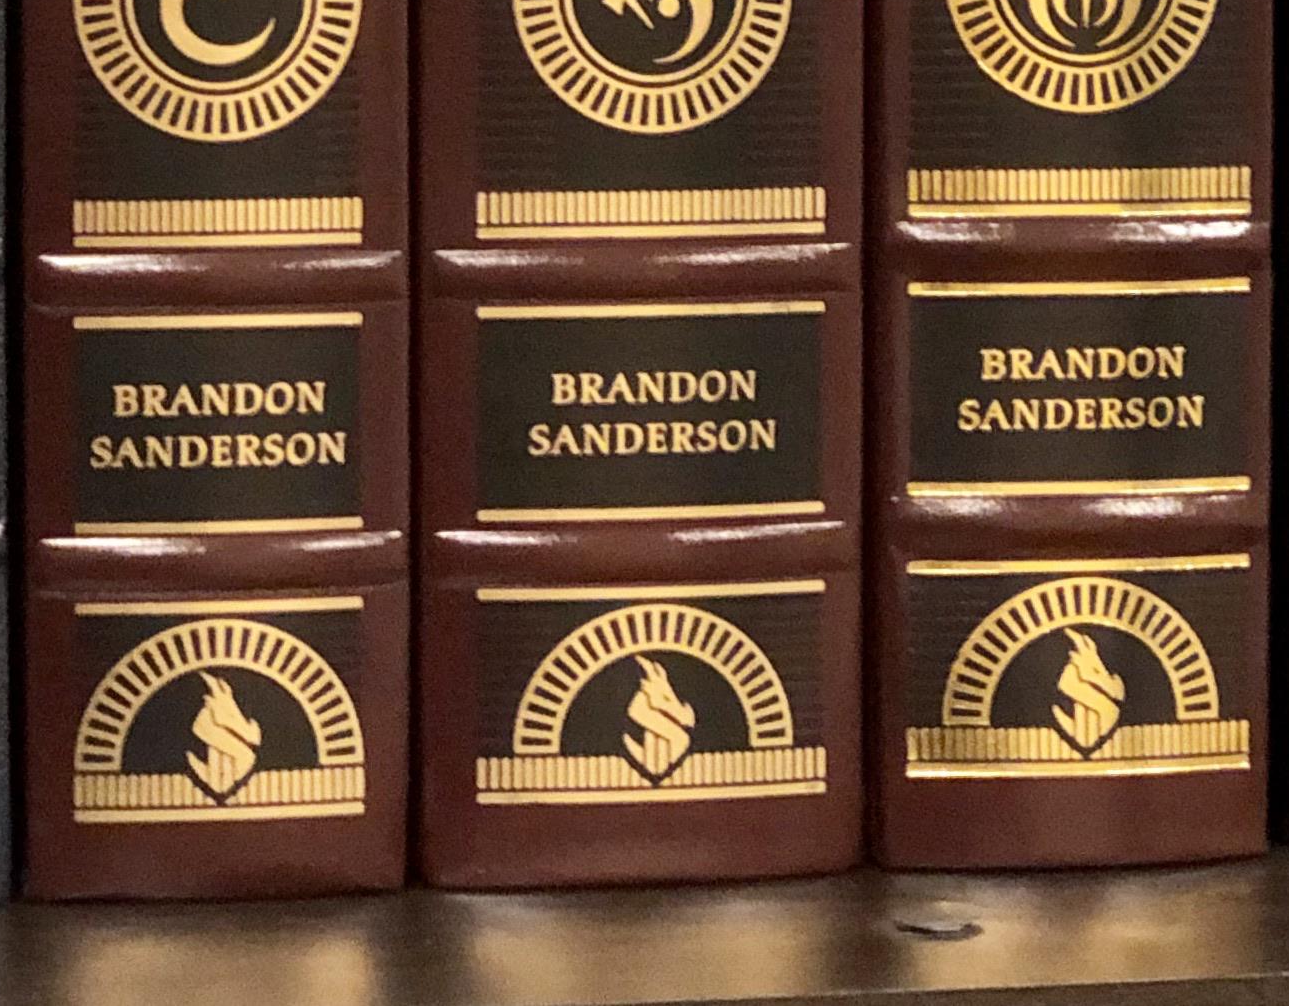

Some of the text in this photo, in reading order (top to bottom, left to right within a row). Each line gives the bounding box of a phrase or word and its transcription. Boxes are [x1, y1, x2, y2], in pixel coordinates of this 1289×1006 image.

[981, 346, 1185, 380] BRANDON
[114, 381, 325, 416] BRANDON
[552, 370, 755, 404] BRANDON
[959, 395, 1204, 431] SANDERSON
[91, 432, 346, 467] SANDERSON
[529, 420, 775, 455] SANDERSON
